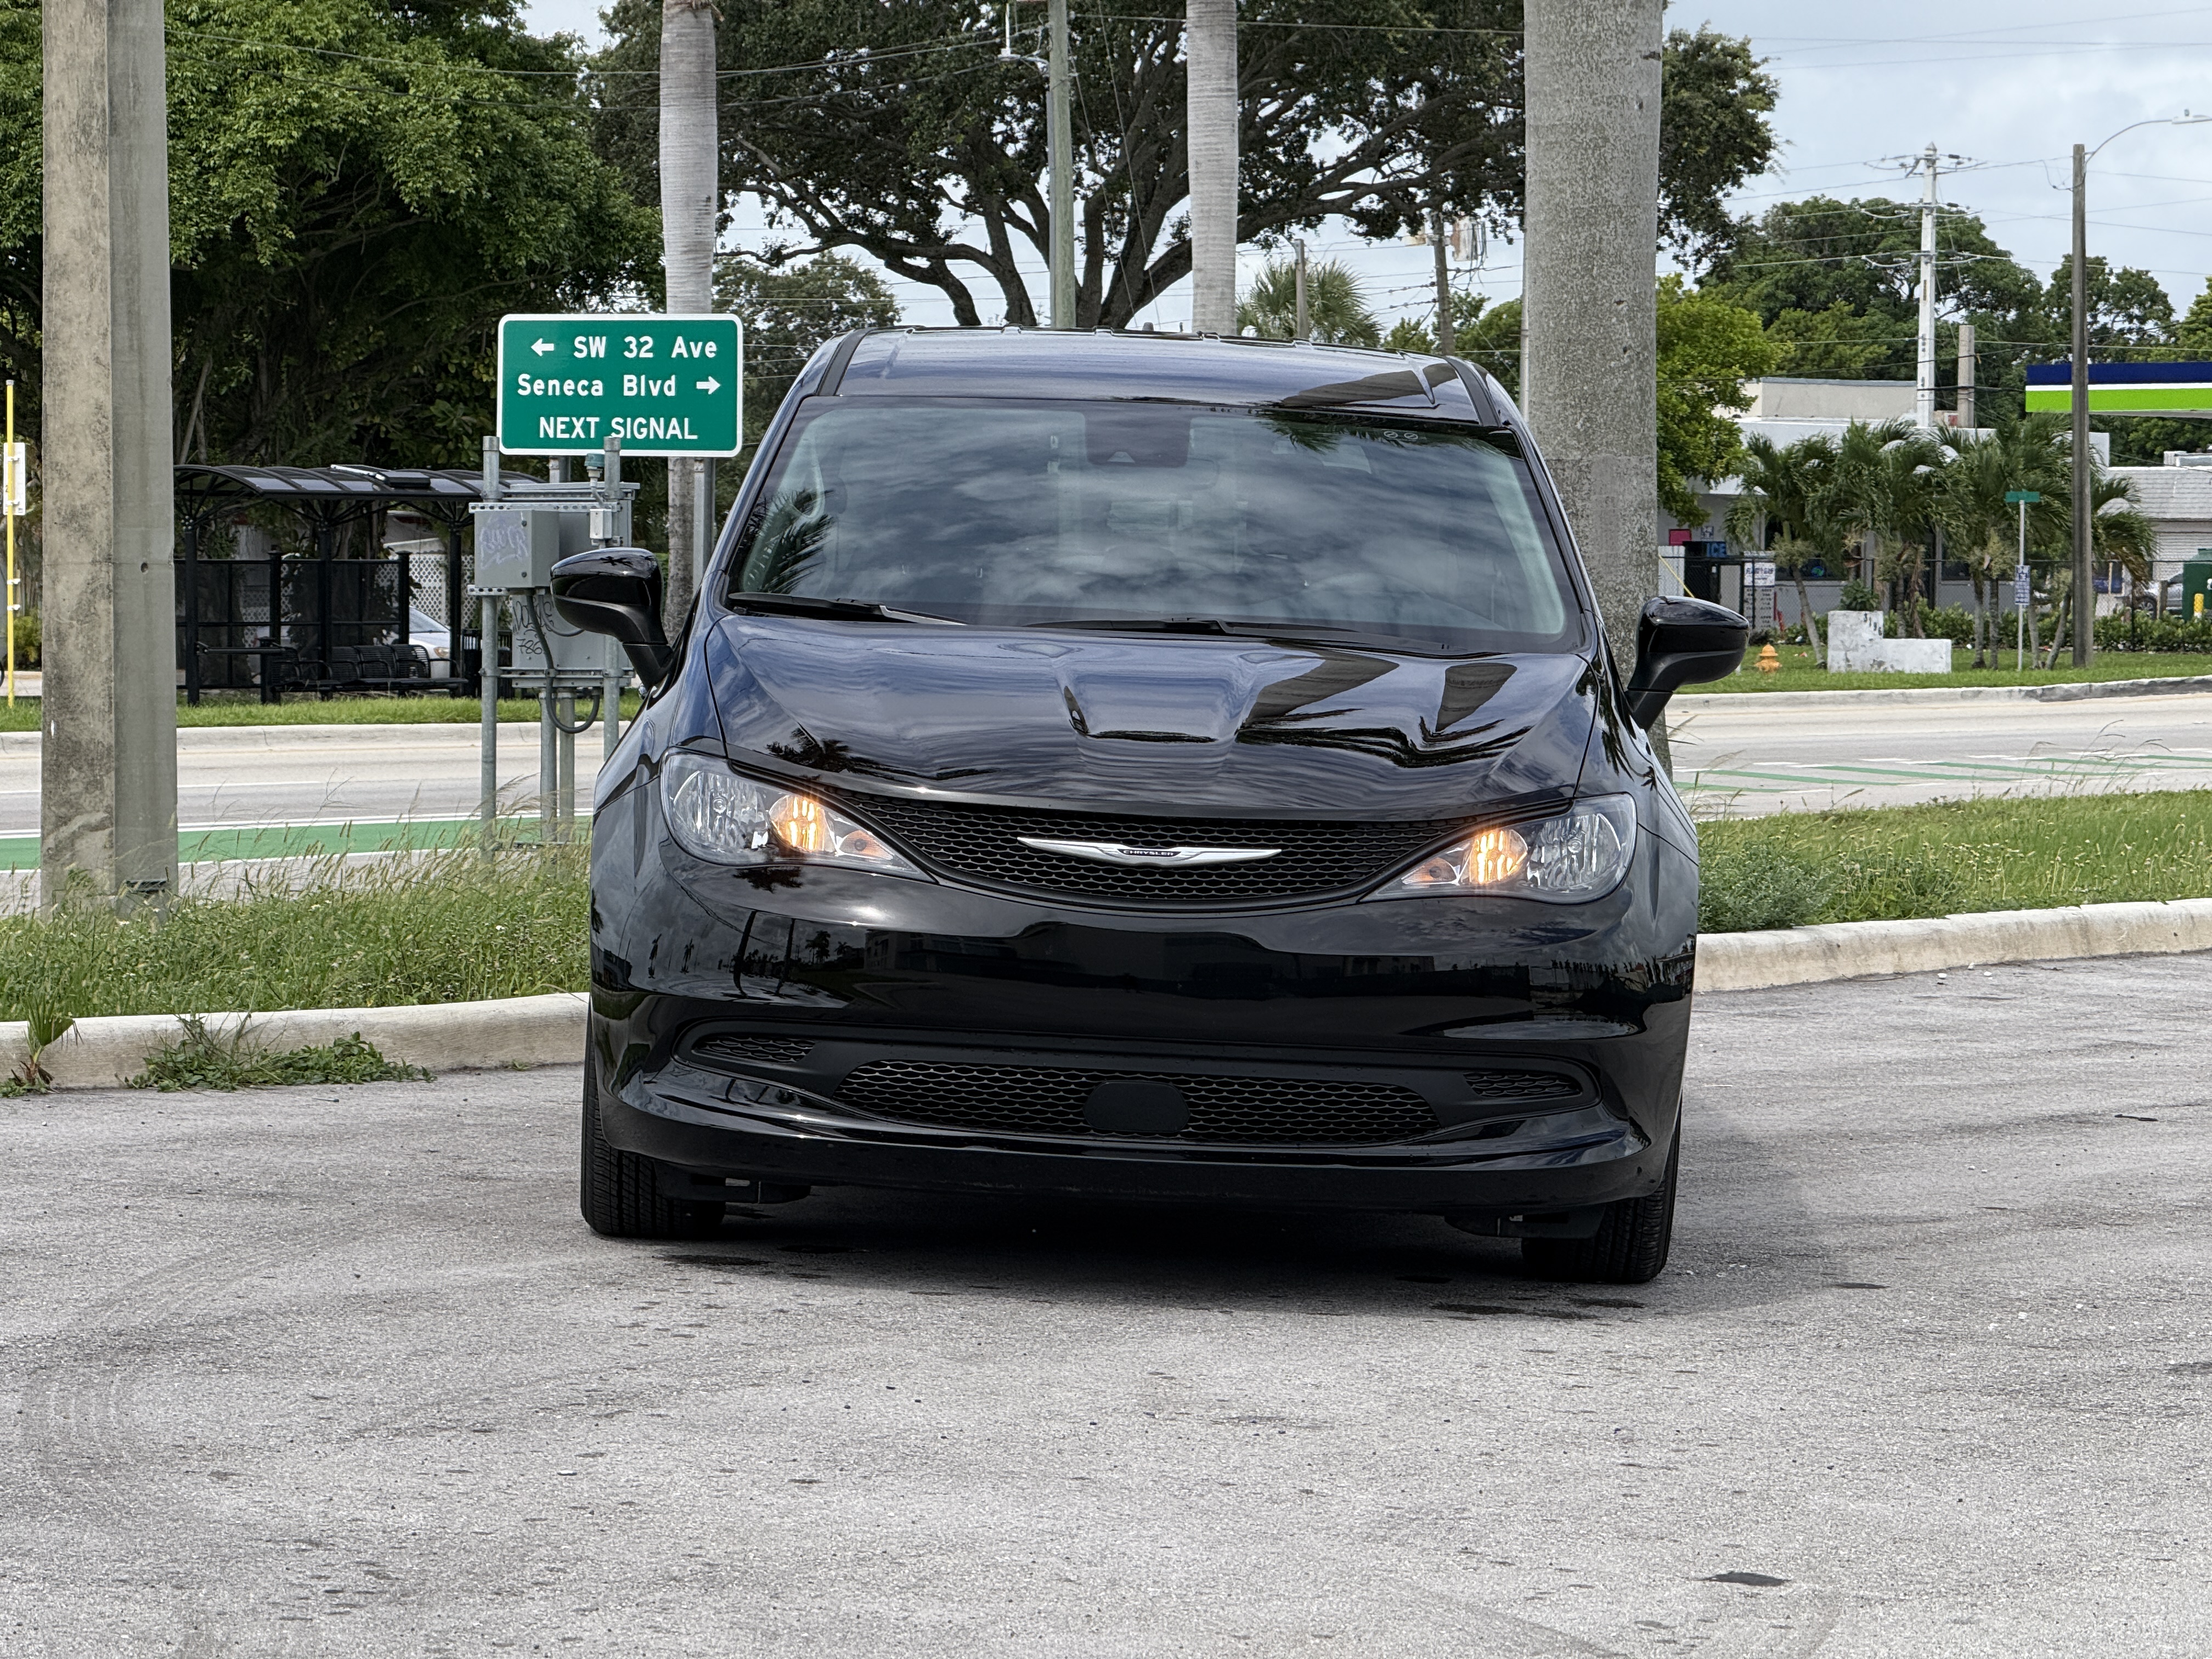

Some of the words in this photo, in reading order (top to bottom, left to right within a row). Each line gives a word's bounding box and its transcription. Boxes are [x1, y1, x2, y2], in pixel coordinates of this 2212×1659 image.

[573, 336, 606, 358] SW
[623, 336, 653, 358] 32
[671, 336, 717, 358] Ave
[517, 374, 603, 396] Seneca
[623, 374, 675, 397] Blvd
[539, 416, 600, 438] NEXT
[611, 417, 698, 439] SIGNAL
[1707, 543, 1726, 557] ICE
[516, 638, 543, 654] 786
